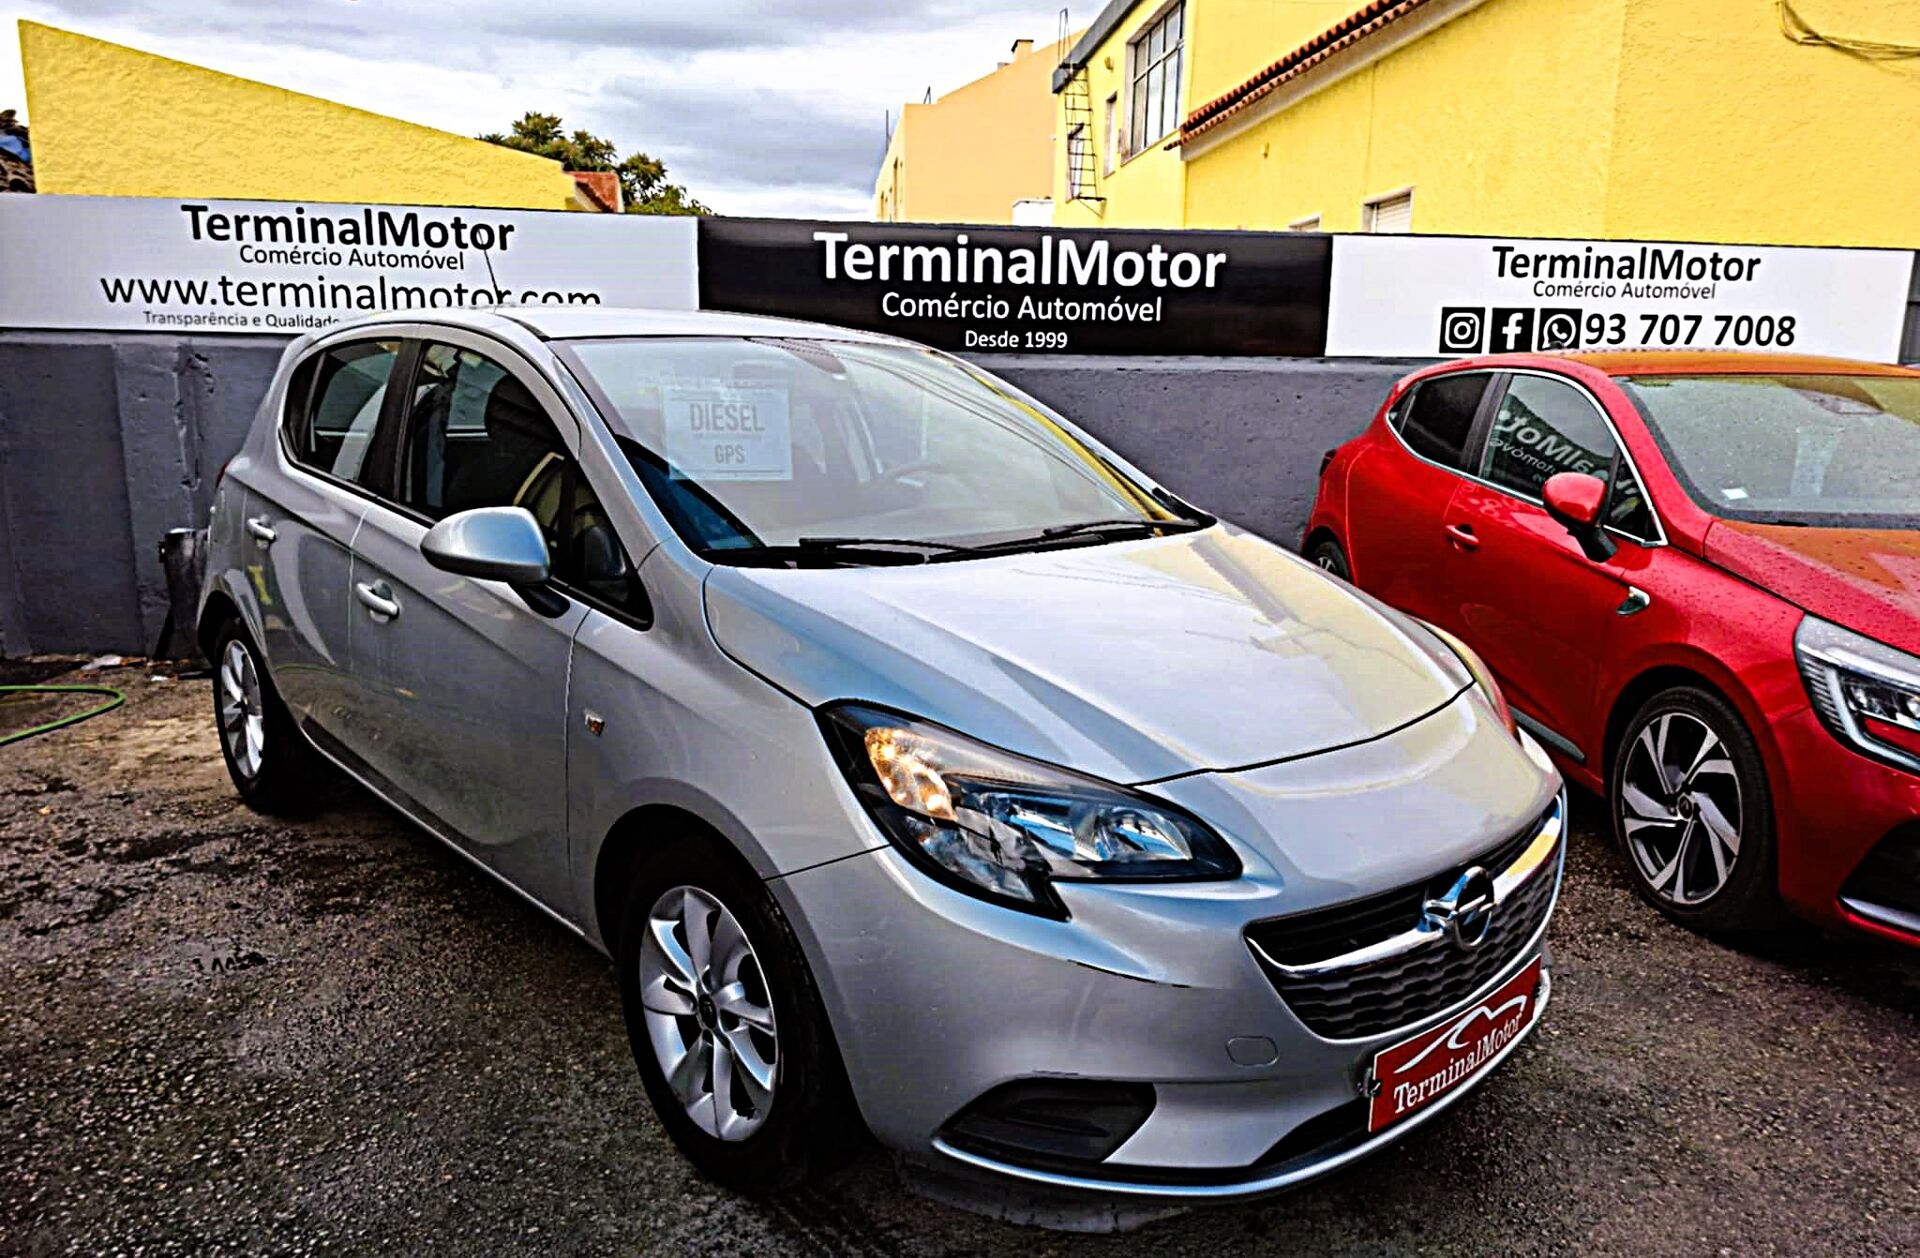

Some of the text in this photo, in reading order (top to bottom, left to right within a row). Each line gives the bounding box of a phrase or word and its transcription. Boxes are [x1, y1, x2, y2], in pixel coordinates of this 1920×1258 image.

[181, 204, 515, 250] TerminalMotor
[240, 244, 465, 270] Comércio Automóvel
[813, 231, 1226, 288] TerminalMotor
[1493, 246, 1761, 282] TerminalMotor
[1533, 280, 1716, 299] Comércio Automóvel
[143, 311, 248, 326] Transparência
[252, 316, 261, 326] e
[882, 292, 1162, 322] Comércio Automóvel
[965, 330, 1068, 349] Desde 1999
[1585, 313, 1796, 347] 93 707 7008
[690, 403, 765, 431] DIESEL
[714, 444, 745, 464] GPS
[1394, 1013, 1522, 1113] TerminalMotor
